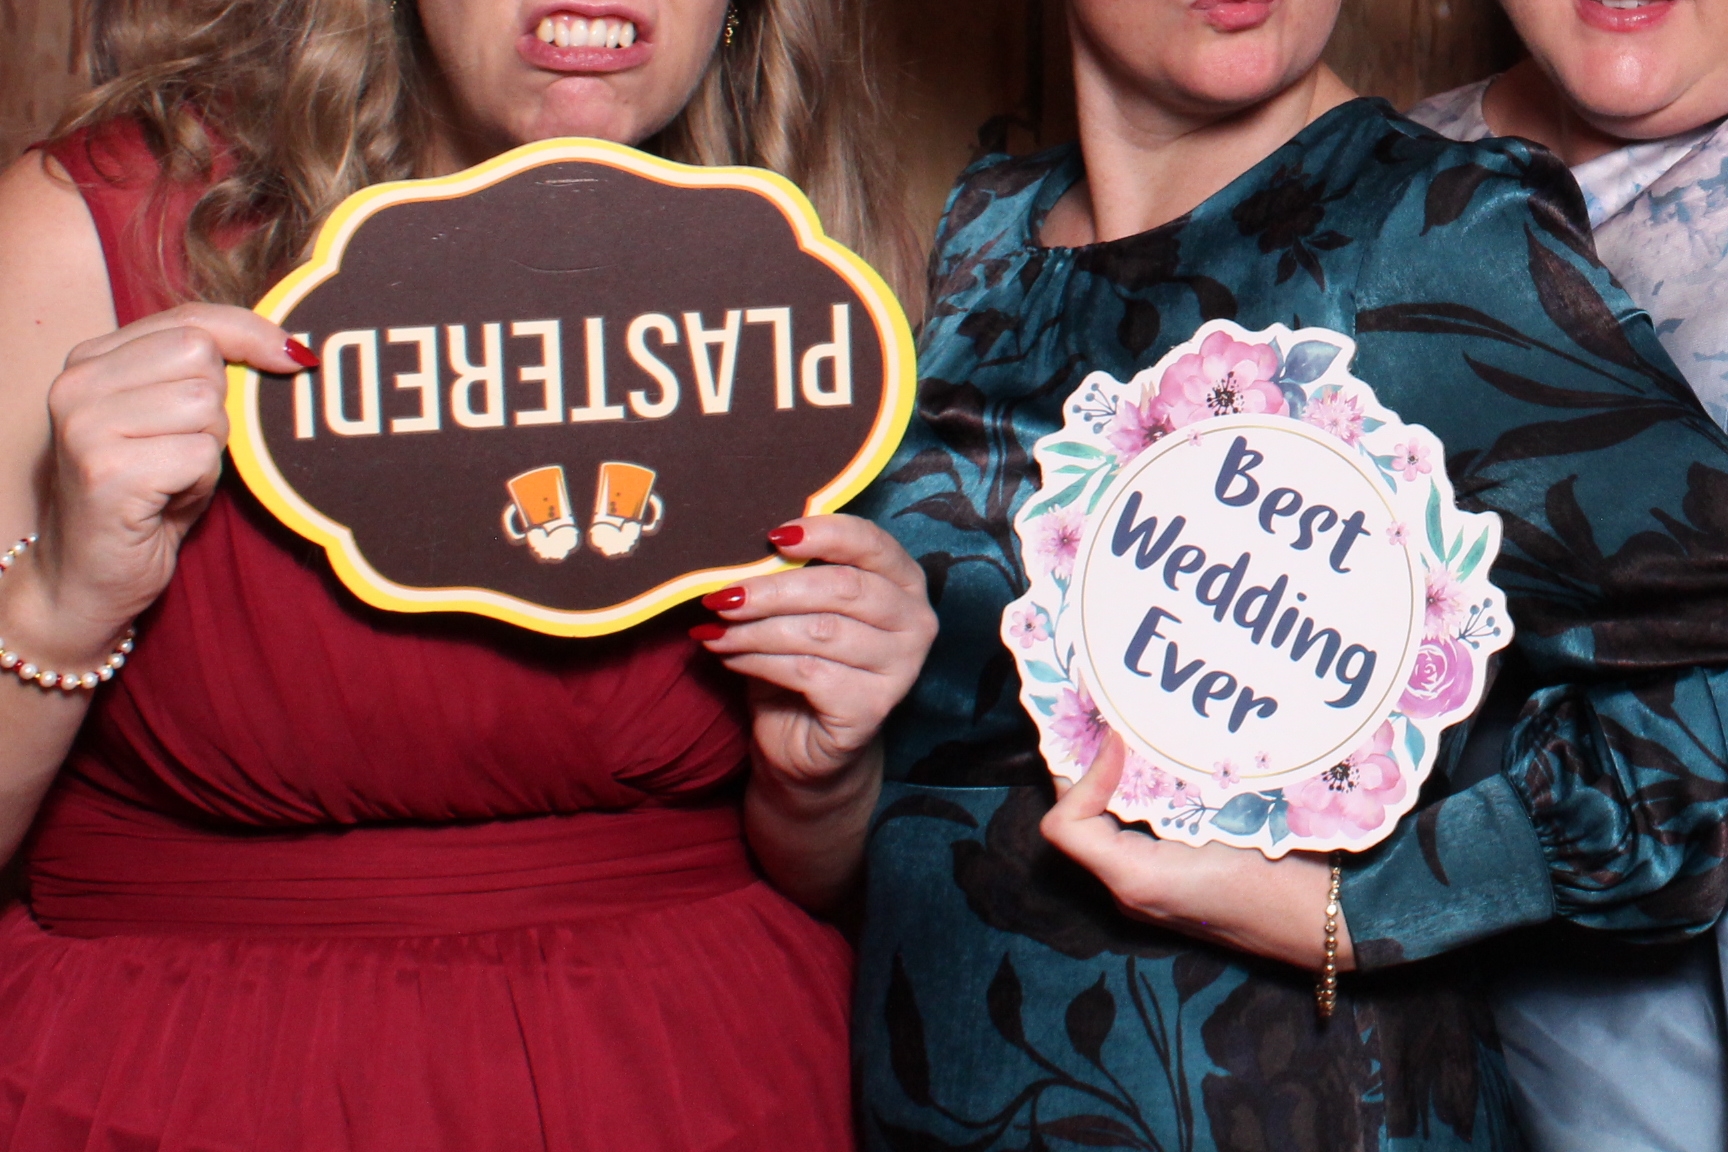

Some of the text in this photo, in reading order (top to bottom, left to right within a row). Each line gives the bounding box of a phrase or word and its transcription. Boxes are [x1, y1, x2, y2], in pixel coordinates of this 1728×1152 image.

[293, 303, 853, 440] PLASTERED!
[1214, 436, 1371, 574] Best
[1111, 491, 1377, 709] Wedding
[1123, 606, 1279, 734] Ever
